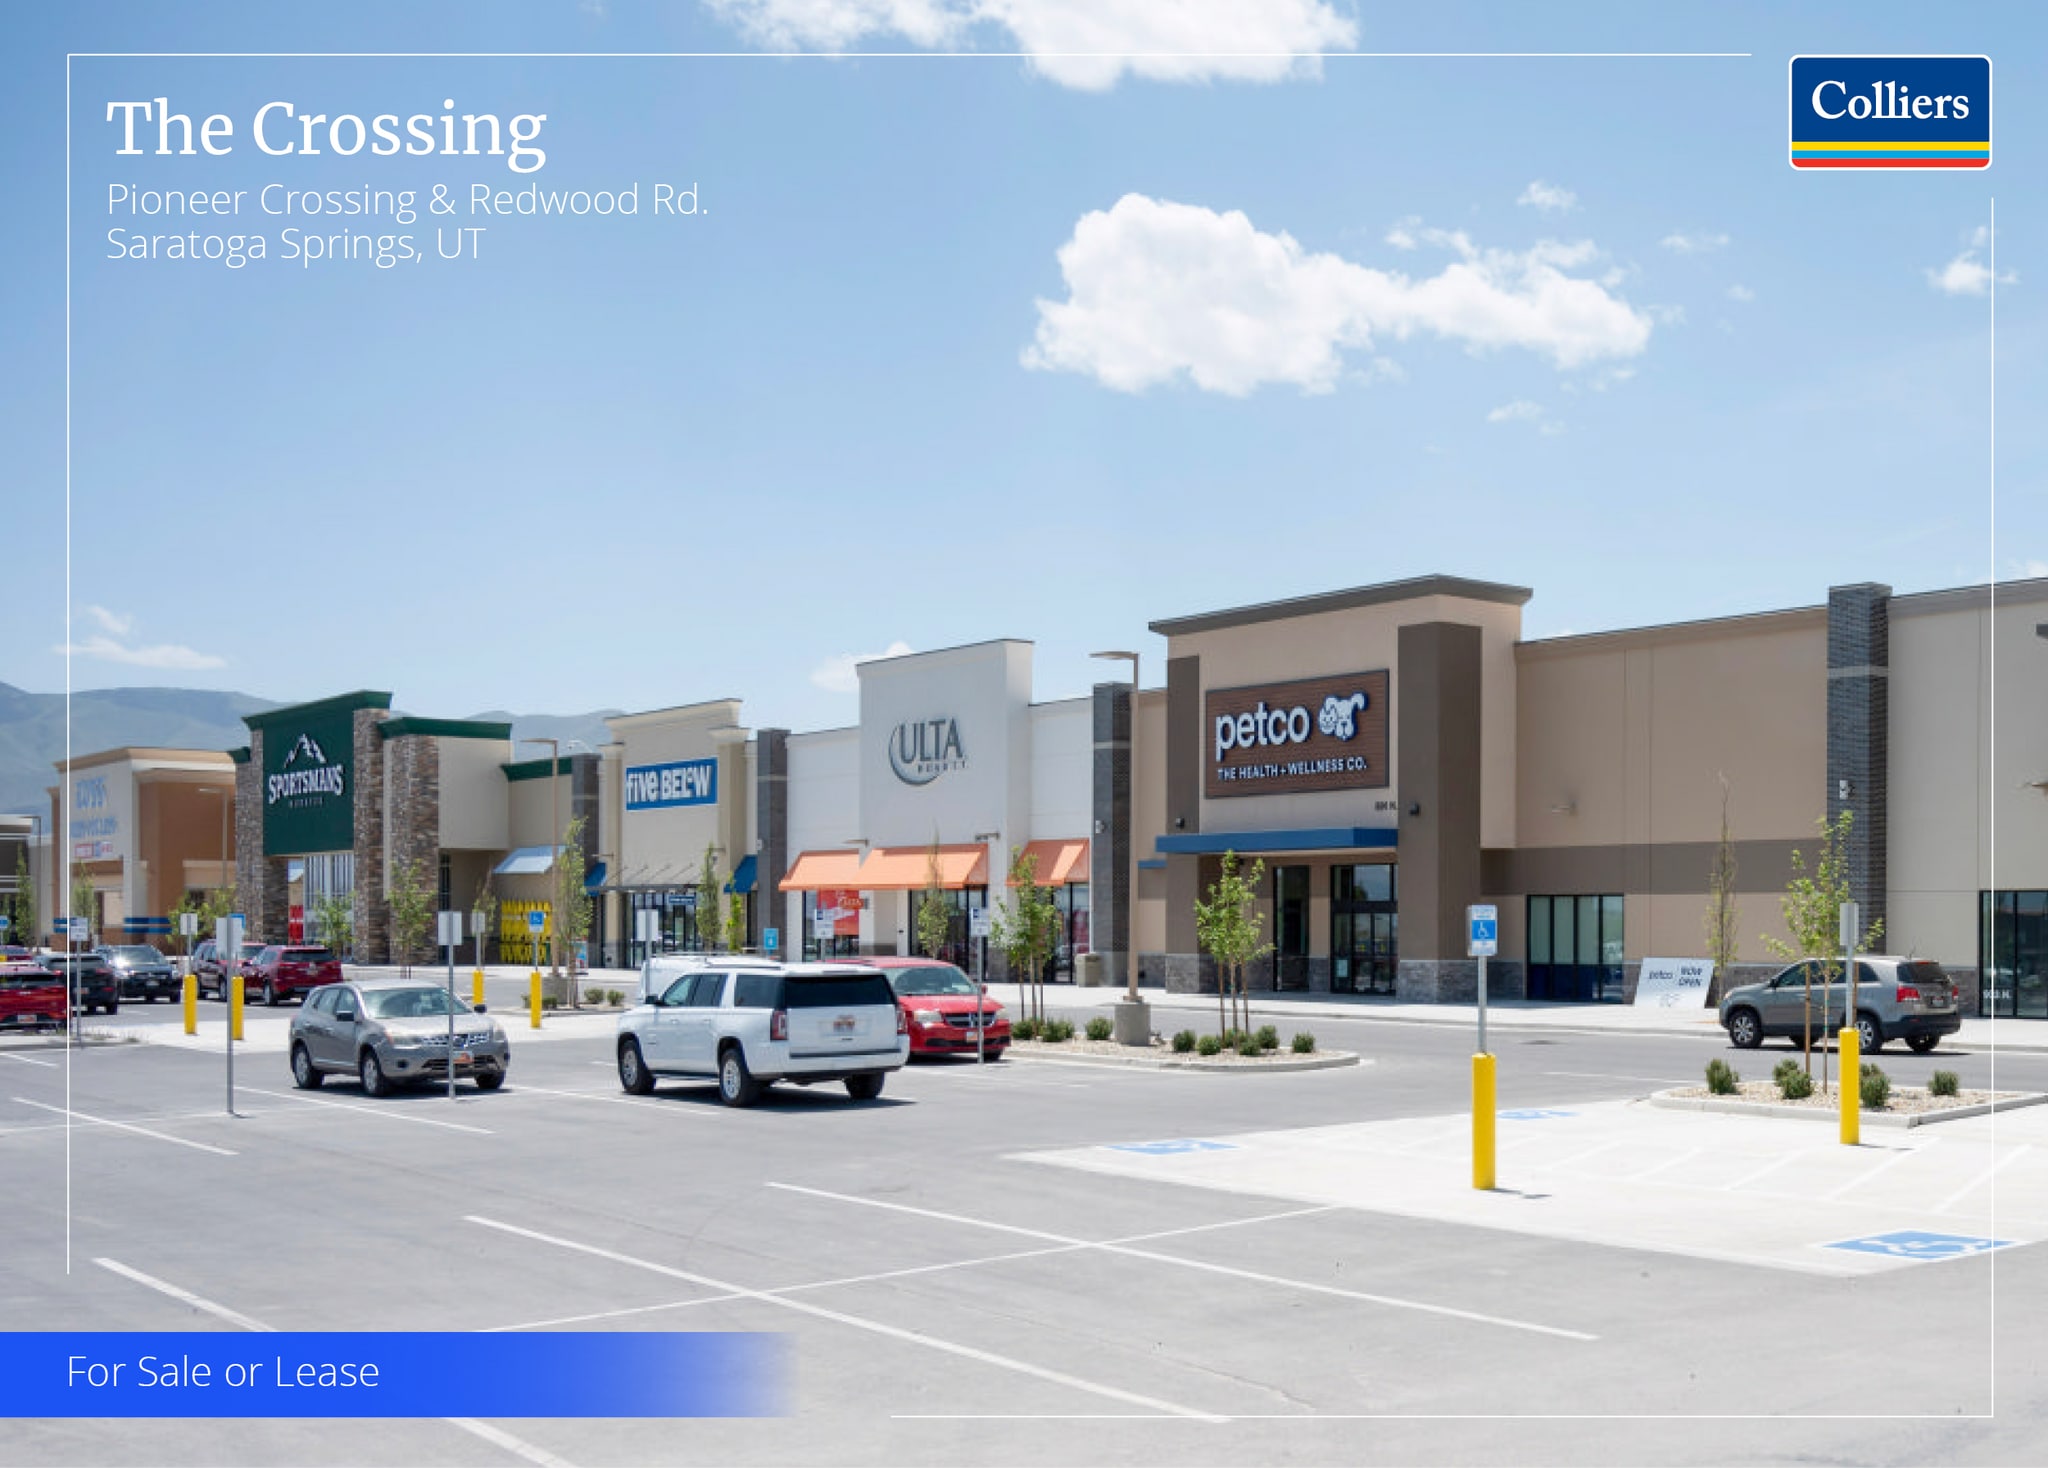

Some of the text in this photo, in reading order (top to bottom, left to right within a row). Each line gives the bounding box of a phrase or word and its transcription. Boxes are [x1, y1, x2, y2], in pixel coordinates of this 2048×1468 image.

[898, 717, 964, 765] ULTA
[1215, 701, 1311, 763] petco
[1217, 767, 1237, 781] THE
[1239, 763, 1279, 780] HEALTH
[1287, 757, 1344, 776] WELLNESS
[1346, 756, 1368, 771] CO.
